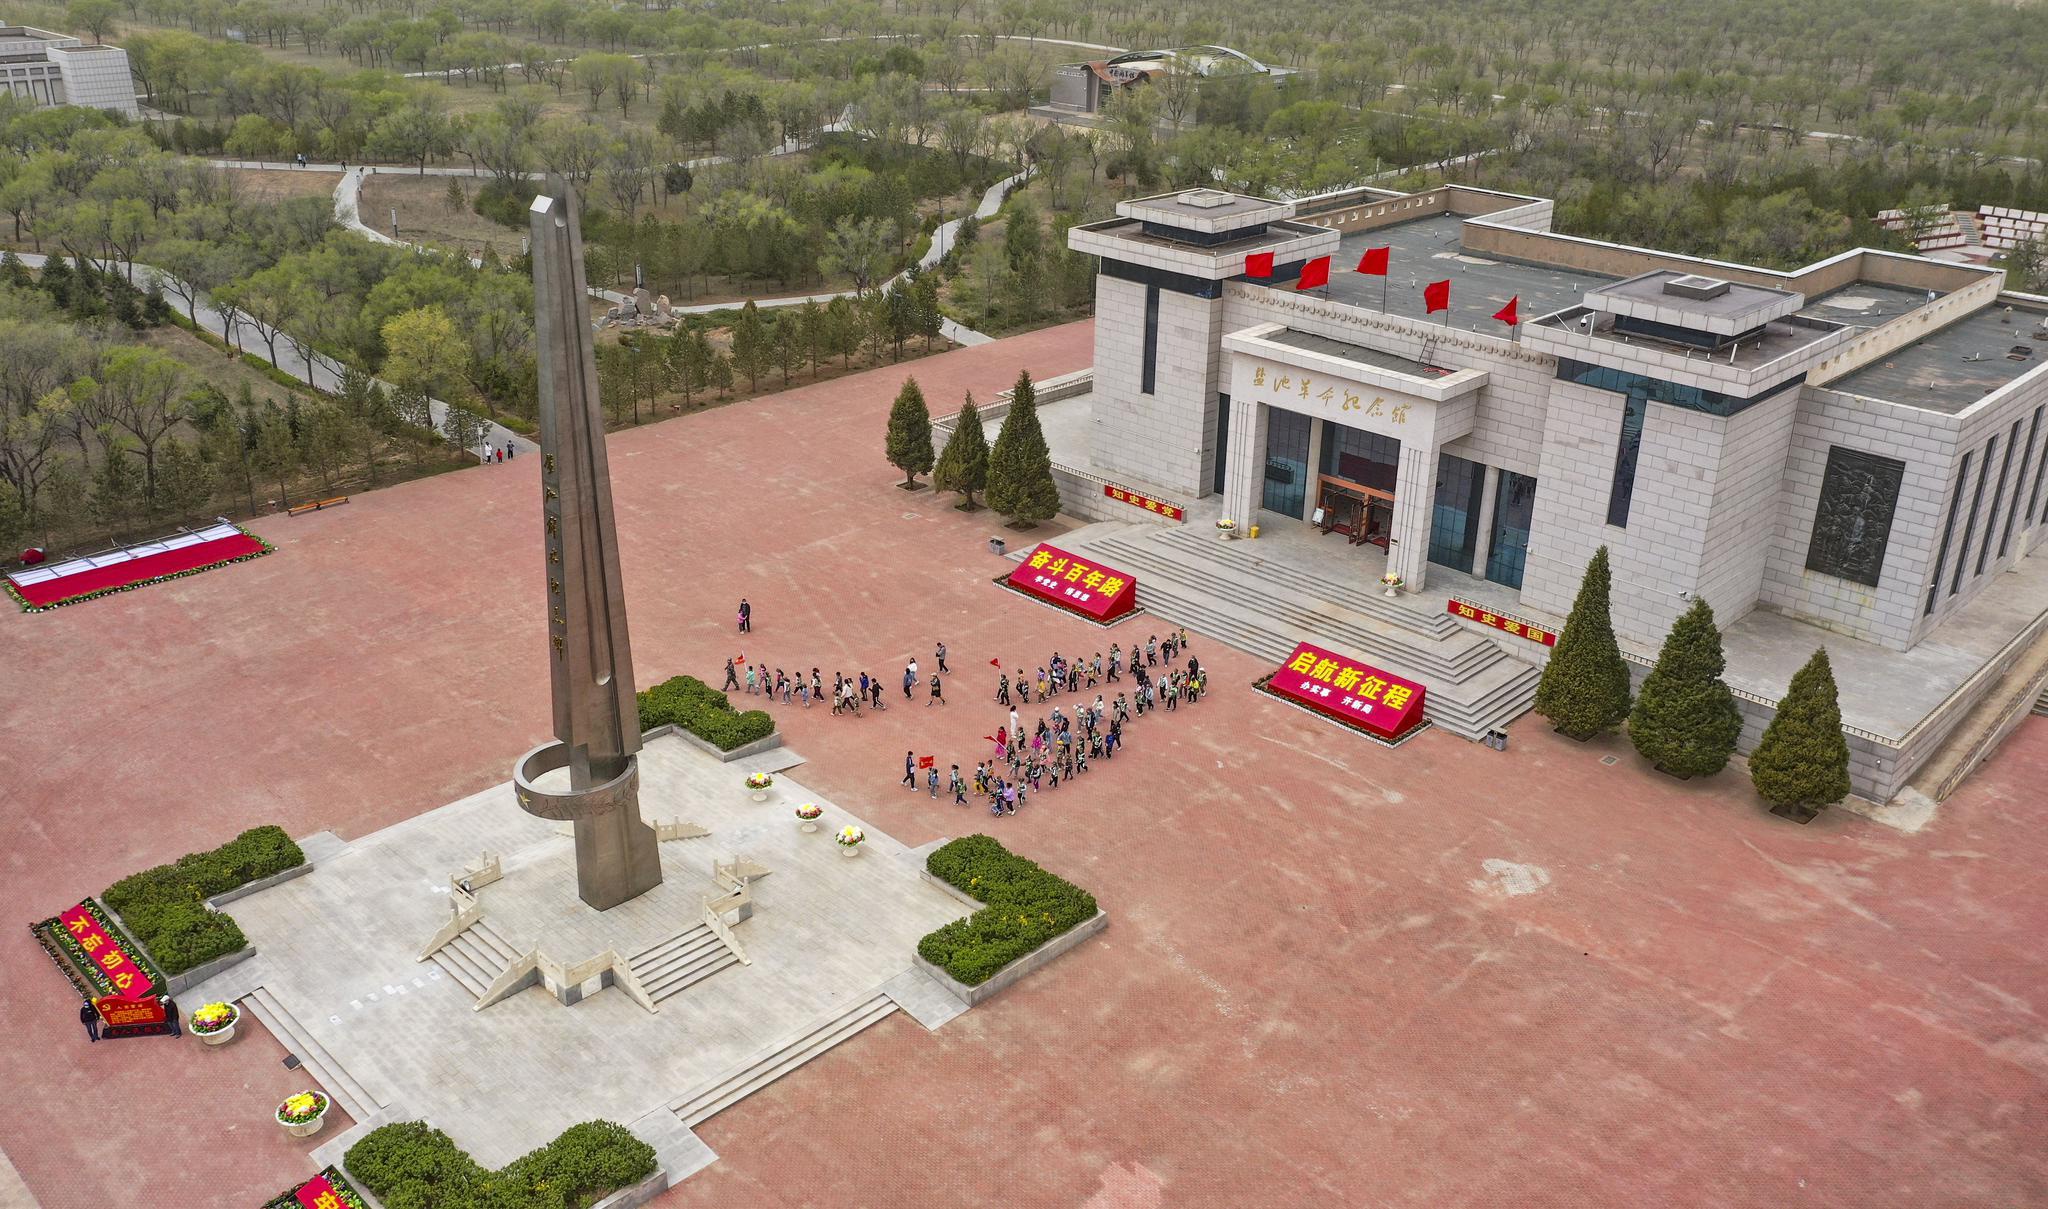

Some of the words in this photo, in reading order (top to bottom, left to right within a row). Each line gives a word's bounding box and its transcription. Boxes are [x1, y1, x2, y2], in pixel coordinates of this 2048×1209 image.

[1112, 488, 1175, 517] 知史爱党
[1028, 550, 1125, 598] 奋斗百年路
[1458, 604, 1544, 642] 知史爱国
[1288, 651, 1414, 711] 启航新征程
[1300, 681, 1332, 697] 办实事
[1341, 696, 1373, 714] 开新局
[69, 915, 134, 990] 不忘初心
